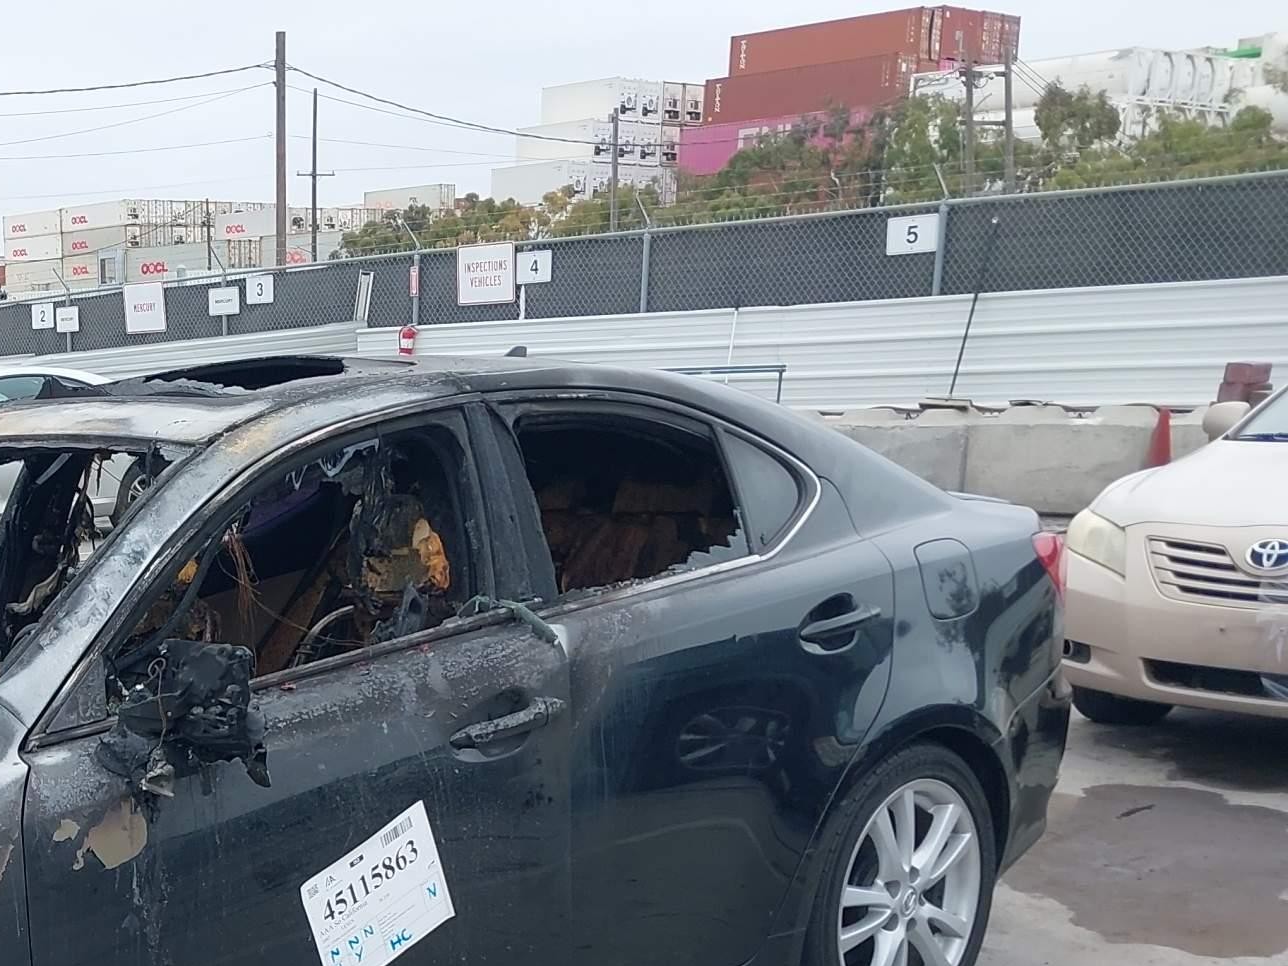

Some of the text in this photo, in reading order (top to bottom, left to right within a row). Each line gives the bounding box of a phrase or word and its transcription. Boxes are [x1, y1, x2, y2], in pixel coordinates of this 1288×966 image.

[72, 216, 88, 225] OOCL
[225, 224, 245, 234] OOCL
[906, 225, 918, 244] 5
[72, 241, 89, 250] OOCL
[72, 266, 89, 275] OOCL
[141, 261, 168, 275] OOCL
[464, 259, 508, 274] INSPECTIONS
[529, 259, 539, 275] 4
[469, 275, 502, 288] VEHICLES
[256, 282, 264, 297] 3
[133, 302, 156, 313] MERCURY
[39, 310, 46, 322] 2
[323, 839, 419, 921] 45115863
[390, 928, 412, 950] HC
